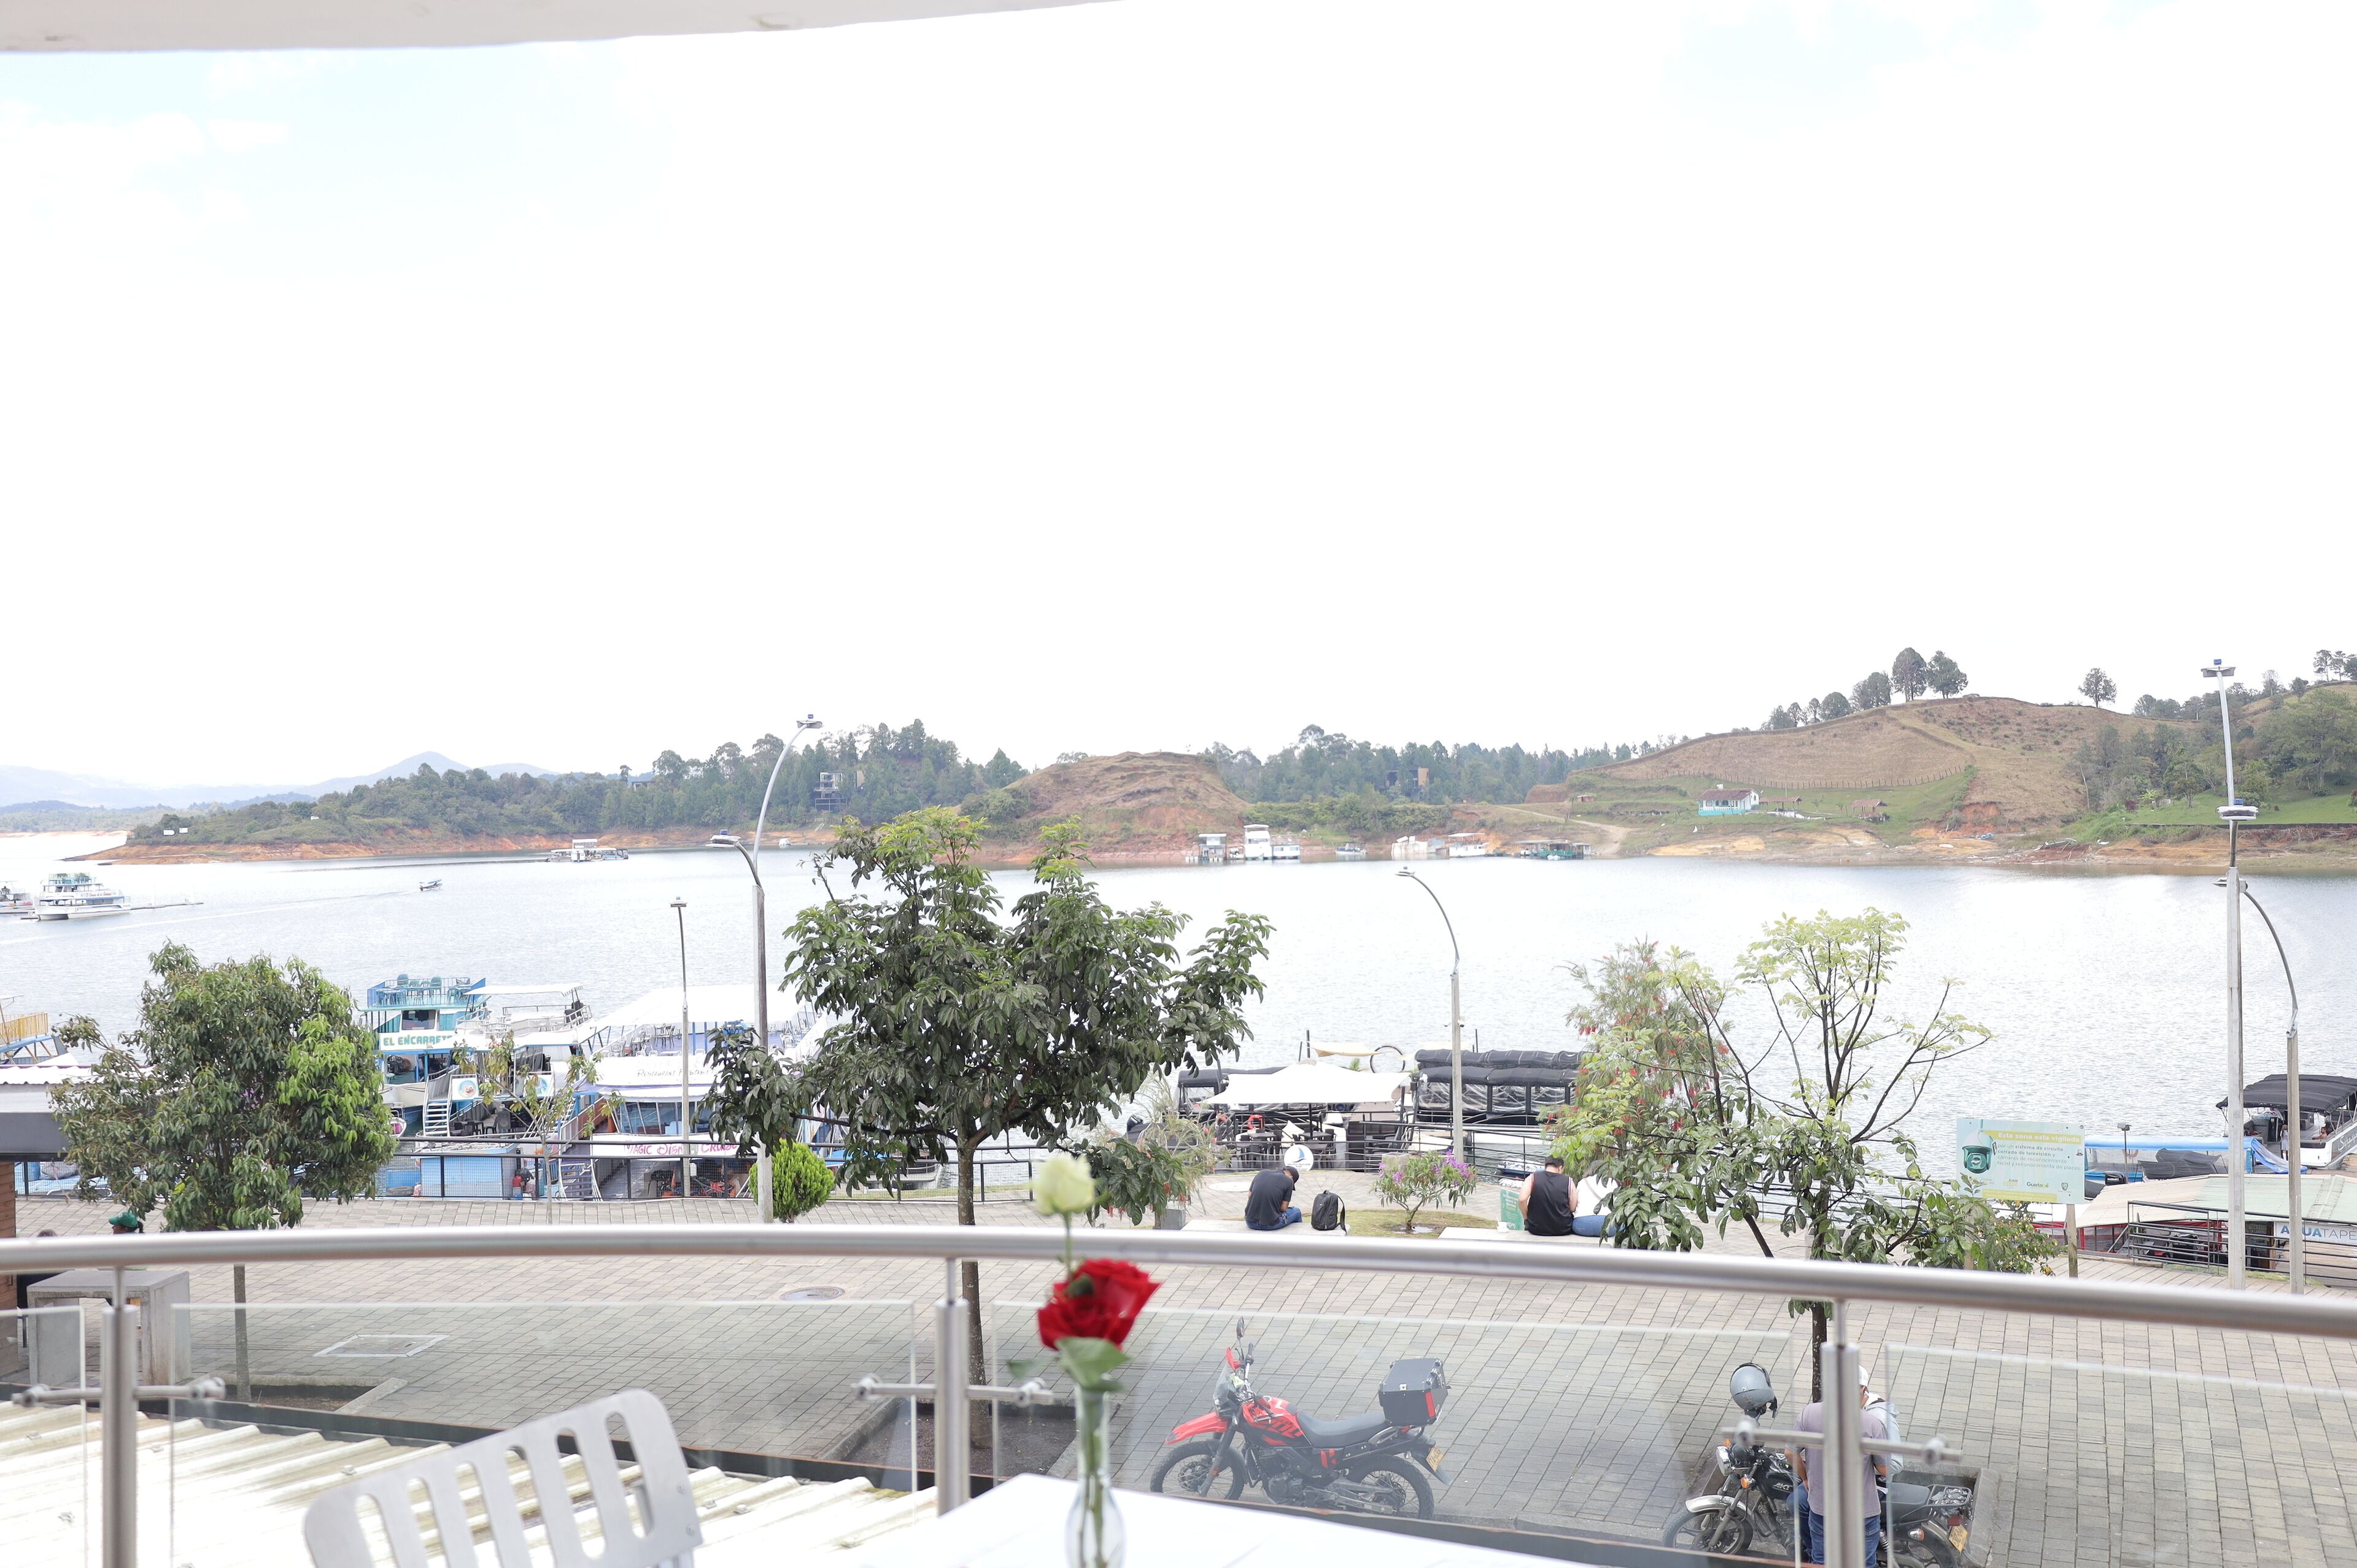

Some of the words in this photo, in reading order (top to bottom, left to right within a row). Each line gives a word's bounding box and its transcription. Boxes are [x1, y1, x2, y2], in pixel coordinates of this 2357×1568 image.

[383, 1037, 395, 1046] EL
[398, 1034, 453, 1045] ENCARRET
[2280, 1225, 2357, 1240] AUATAPÉ
